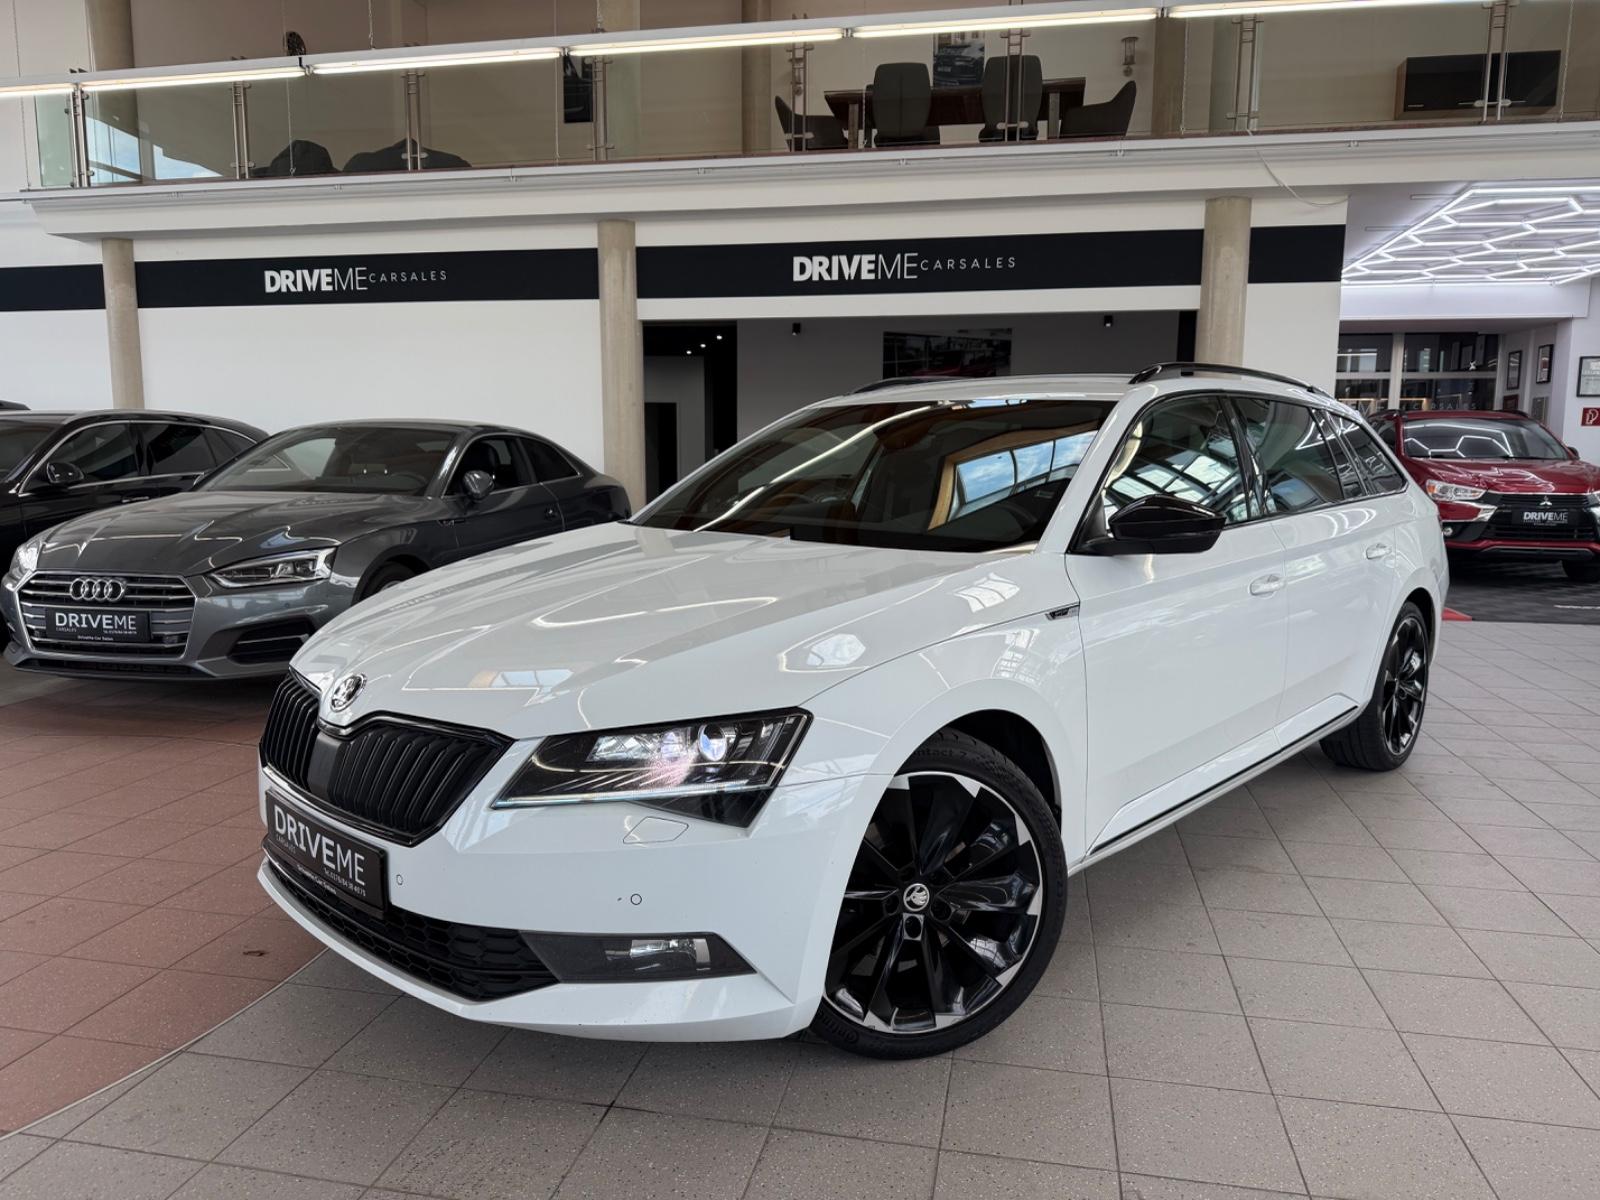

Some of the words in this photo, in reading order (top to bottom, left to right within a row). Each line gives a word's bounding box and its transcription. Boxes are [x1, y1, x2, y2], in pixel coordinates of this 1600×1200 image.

[264, 267, 368, 293] DRIVEME
[369, 270, 447, 283] CARSALES
[793, 253, 918, 282] DRIVEME
[920, 257, 1016, 270] CARSALES
[1523, 511, 1568, 521] DRIVEME
[55, 612, 137, 630] DRIVEME
[274, 804, 365, 887] DRIVEME
